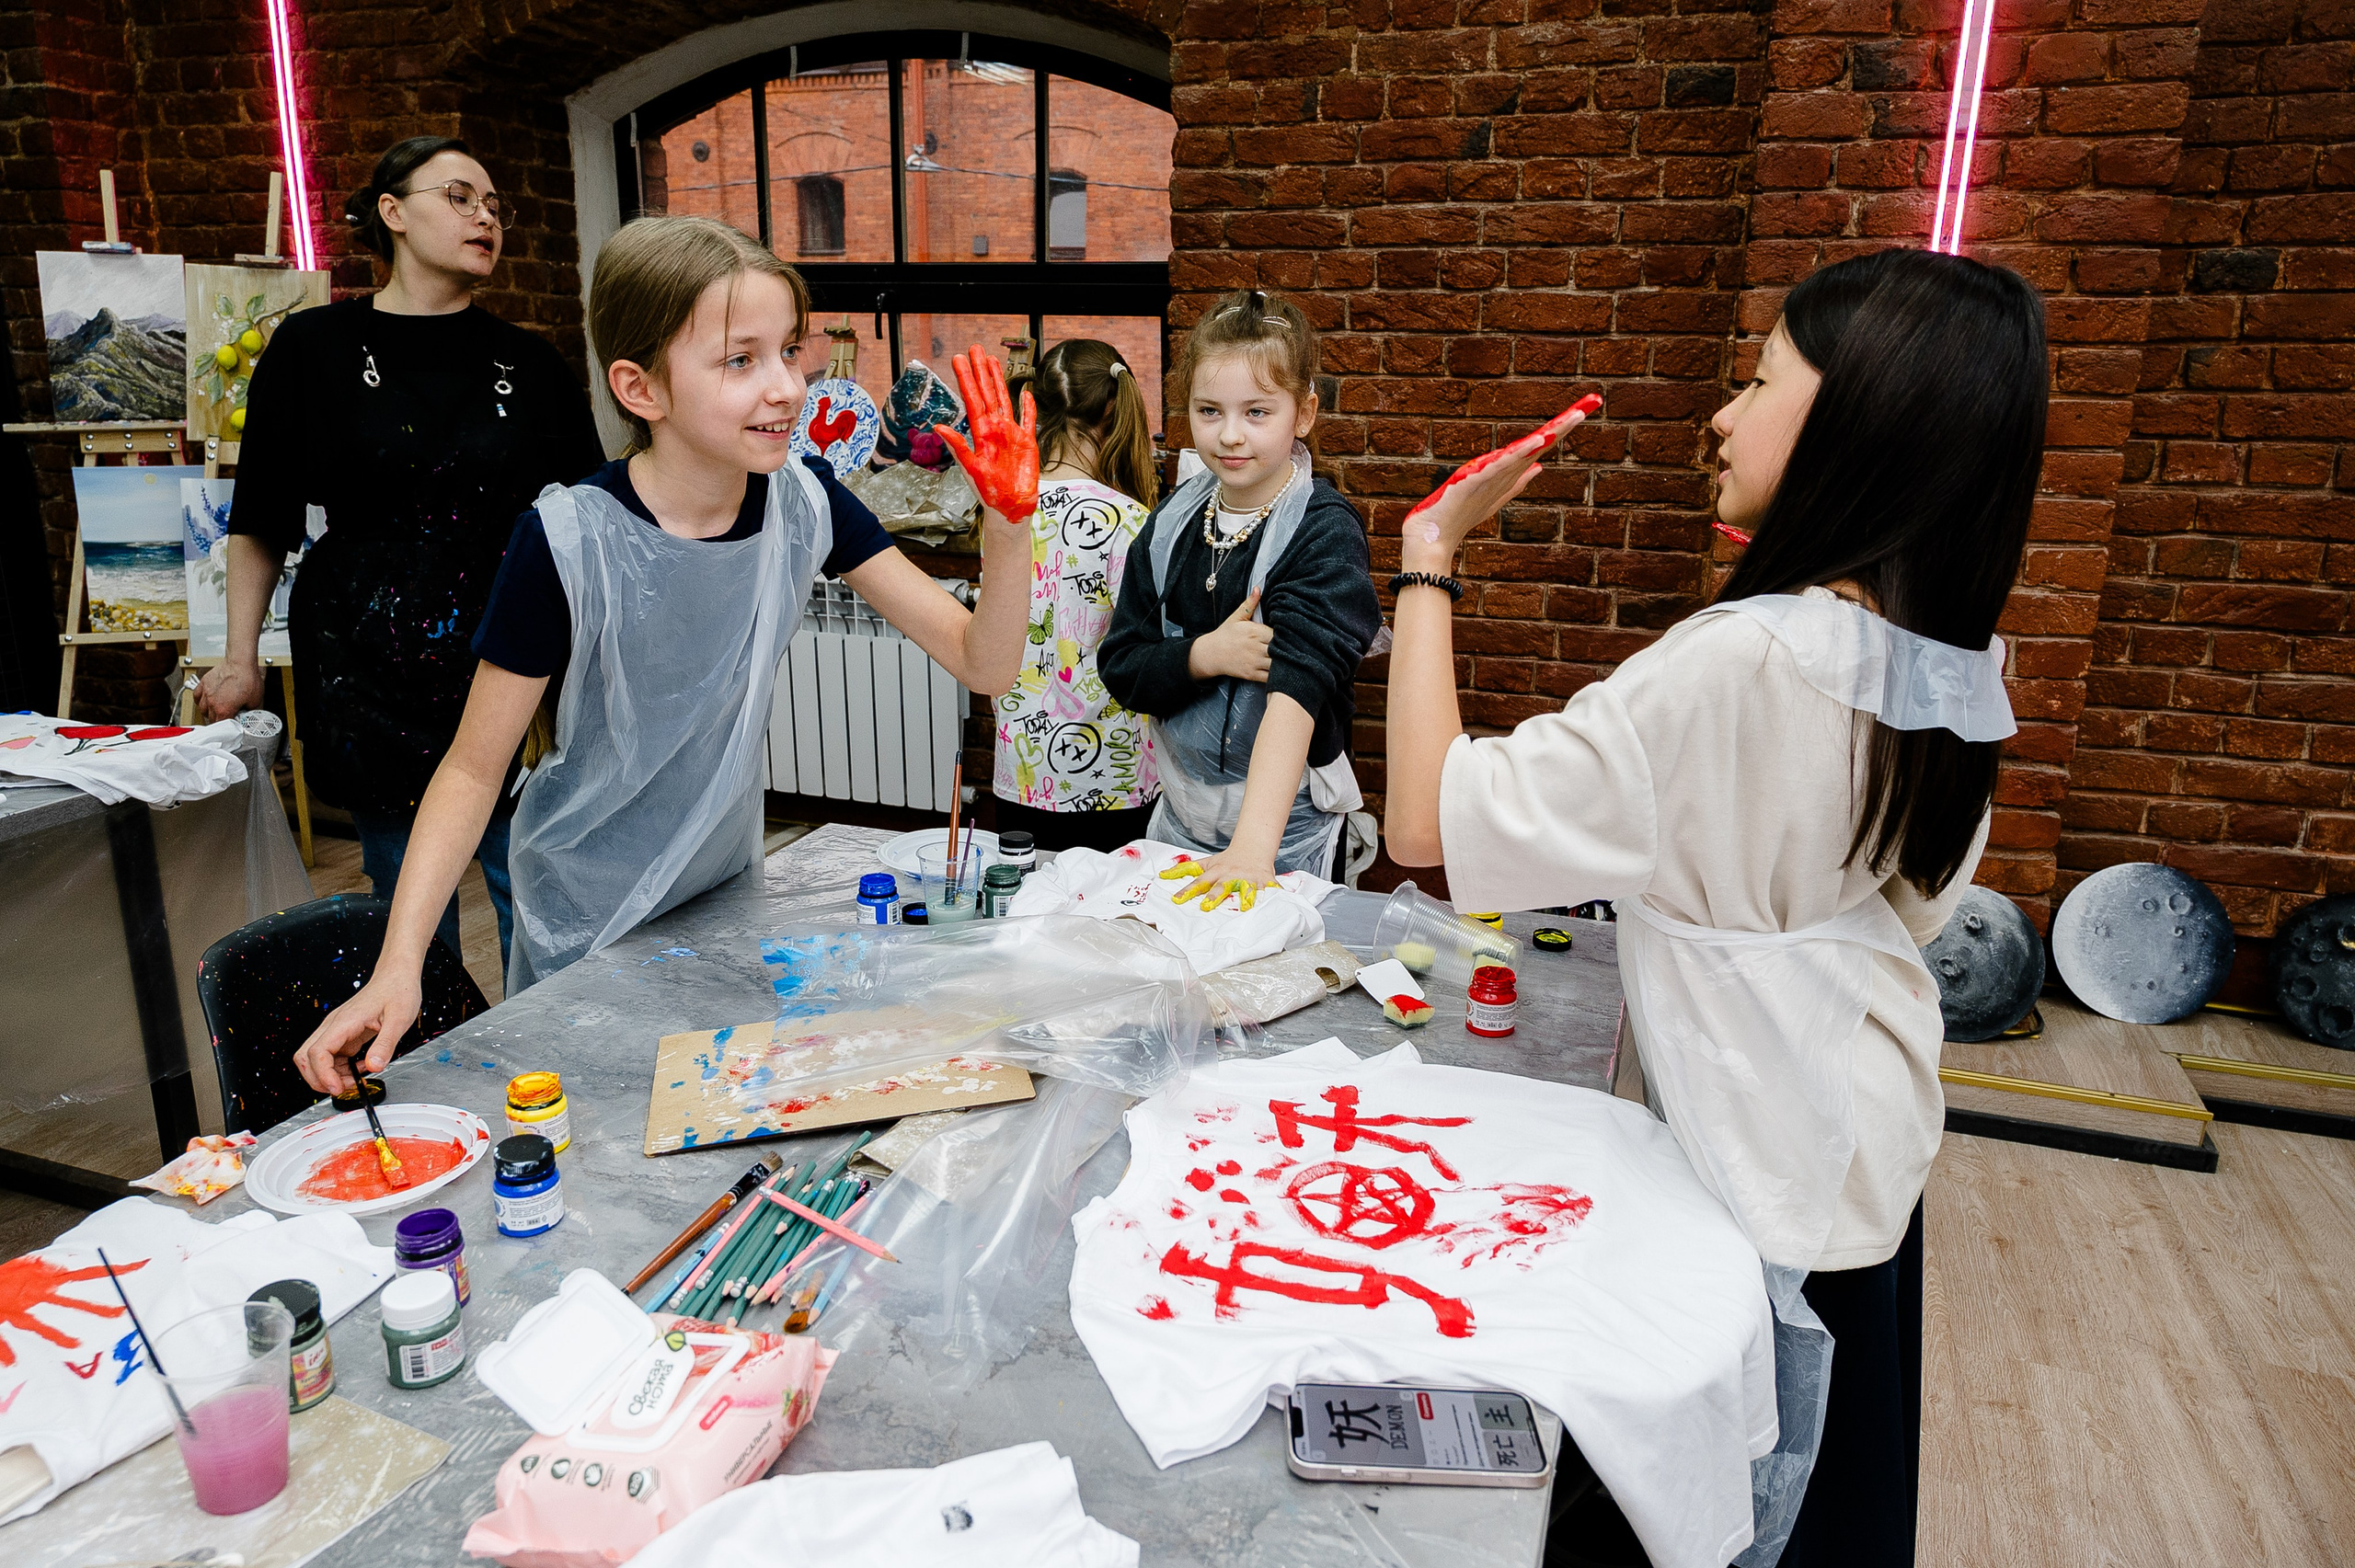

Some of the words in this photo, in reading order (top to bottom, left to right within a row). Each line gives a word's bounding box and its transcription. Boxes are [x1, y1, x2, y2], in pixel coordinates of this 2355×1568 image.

[1014, 713, 1059, 737] TODAY
[1104, 727, 1138, 795] AMOR
[1325, 1399, 1391, 1448] 妖
[1384, 1404, 1409, 1450] DEMON
[1484, 1404, 1515, 1427] 主
[1492, 1434, 1520, 1468] 死亡
